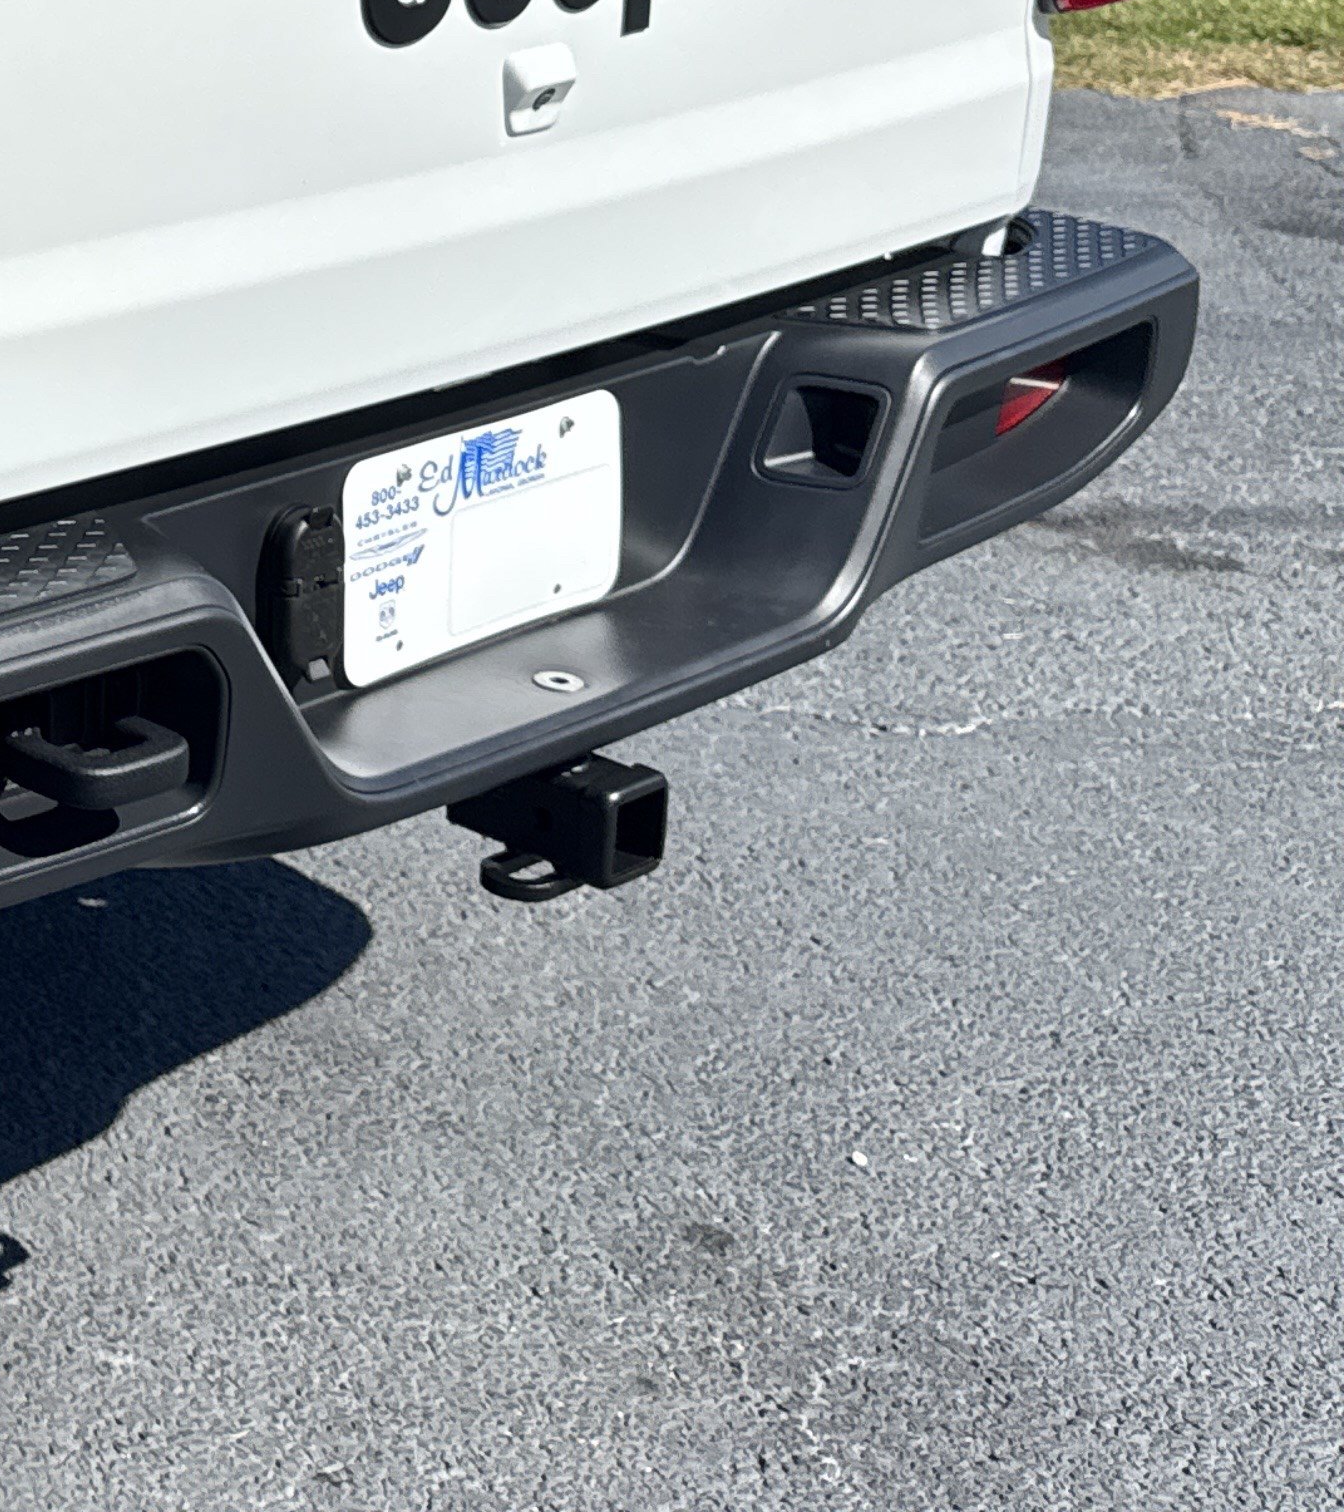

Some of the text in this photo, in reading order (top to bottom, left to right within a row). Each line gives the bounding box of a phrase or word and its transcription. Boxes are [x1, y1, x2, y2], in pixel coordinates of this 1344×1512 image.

[418, 454, 453, 493] Ed
[433, 443, 547, 517] Murdock
[355, 496, 420, 530] 453-3433
[369, 575, 405, 600] Jeep
